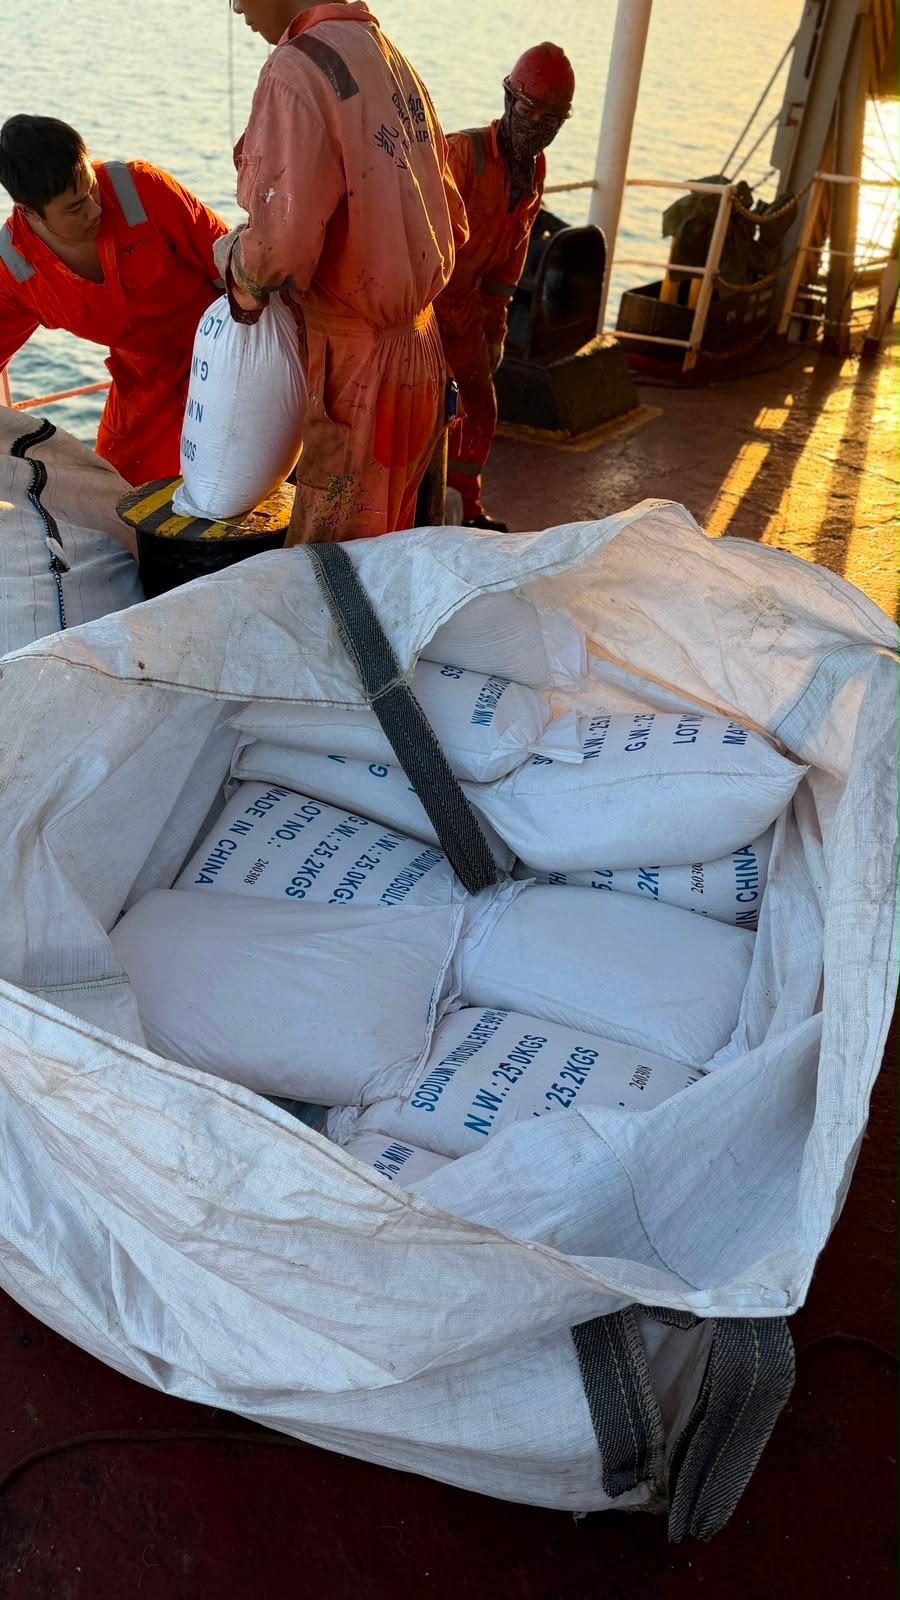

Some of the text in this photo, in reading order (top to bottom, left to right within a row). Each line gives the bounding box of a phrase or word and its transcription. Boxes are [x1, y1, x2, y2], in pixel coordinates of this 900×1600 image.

[440, 664, 466, 680] GS
[470, 709, 495, 727] MIN
[672, 721, 701, 745] LOT
[194, 787, 289, 884] MADE IN CHINA
[243, 800, 330, 885] LOT NO.: 260308
[285, 840, 339, 899] 25.2KGS
[731, 844, 759, 902] CHINA
[410, 1066, 458, 1113] SODIUM
[438, 1022, 500, 1067] THIOSULFATE
[463, 1034, 549, 1137] N.W.: 25.0KGS
[545, 1046, 600, 1109] 25.2KGS
[629, 1063, 653, 1091] 260308
[381, 1141, 416, 1166] MIN
